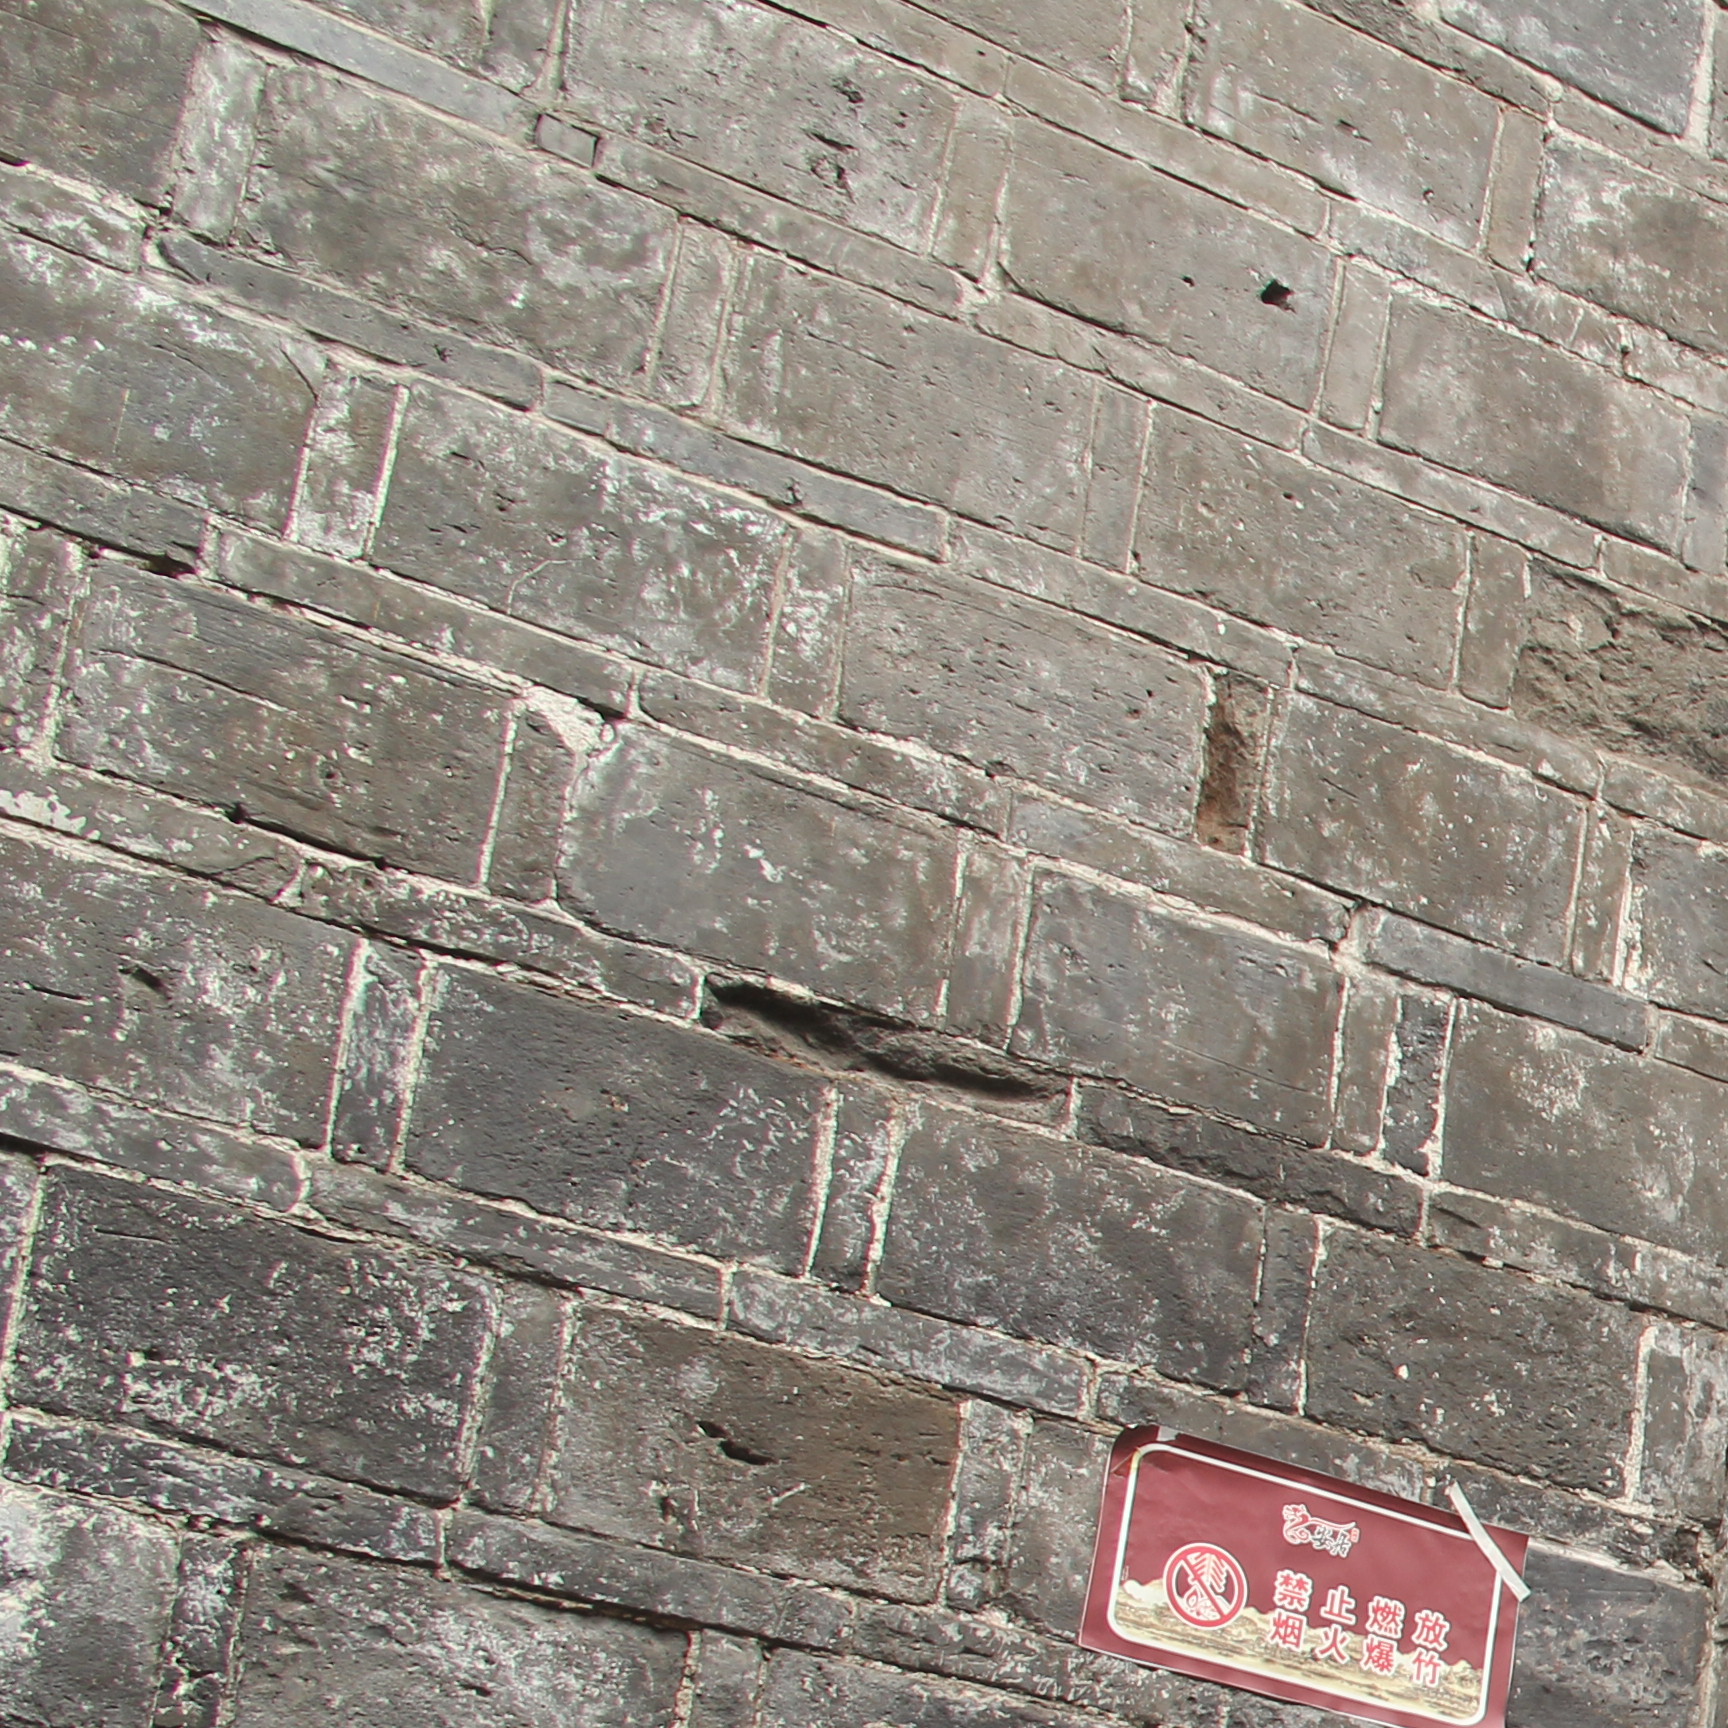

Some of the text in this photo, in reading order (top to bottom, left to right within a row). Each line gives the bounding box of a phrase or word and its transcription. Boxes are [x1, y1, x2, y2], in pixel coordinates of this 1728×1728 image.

[1273, 1570, 1452, 1649] 禁止燃放
[1269, 1612, 1444, 1688] 烟火爆竹
